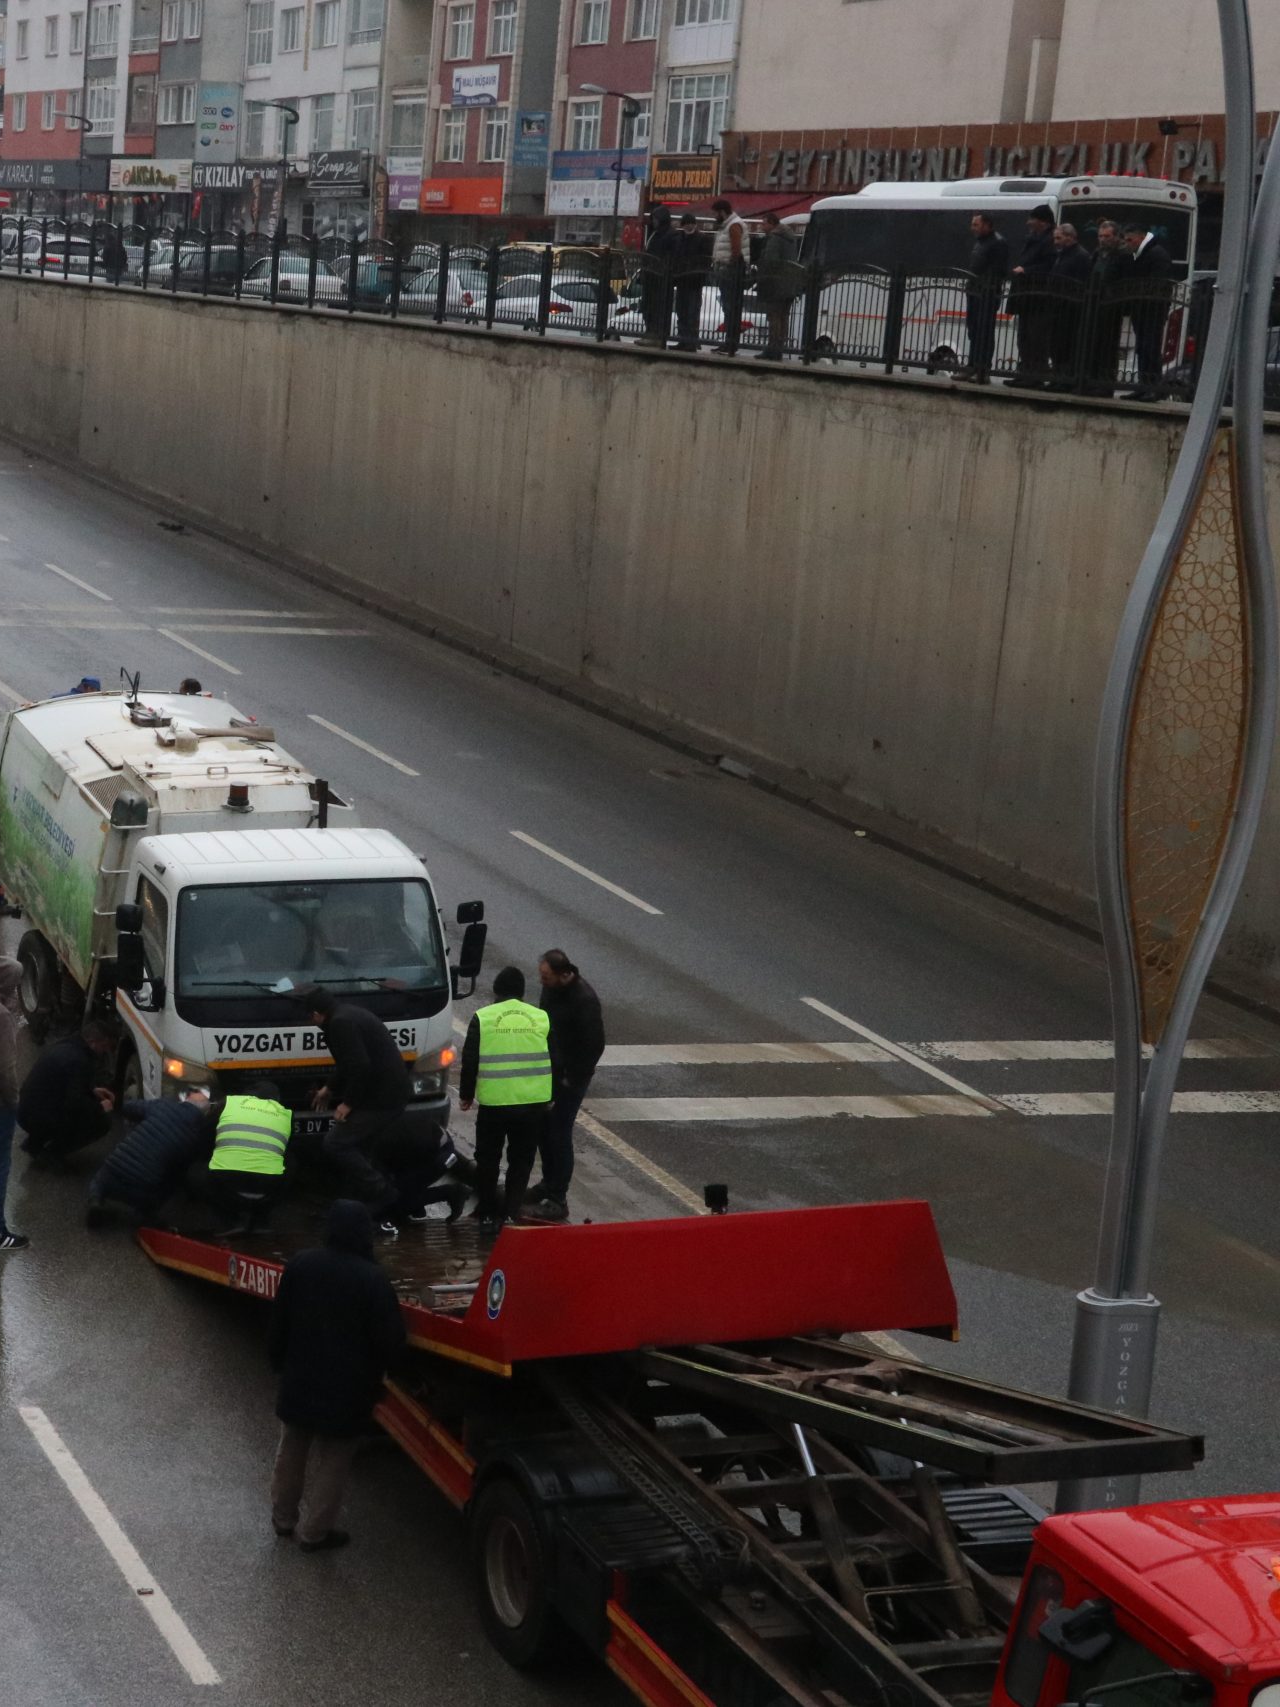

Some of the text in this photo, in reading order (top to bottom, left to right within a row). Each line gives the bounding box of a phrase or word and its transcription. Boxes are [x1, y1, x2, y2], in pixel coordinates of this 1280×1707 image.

[765, 138, 970, 186] ZEYTİNBURNU
[984, 141, 1153, 178] UCUZLUK
[6, 165, 34, 184] KARACA
[205, 166, 246, 187] KIZILAY
[655, 170, 712, 188] DEKOR PERDE
[214, 1032, 296, 1053] YOZGAT
[306, 1120, 322, 1132] DV
